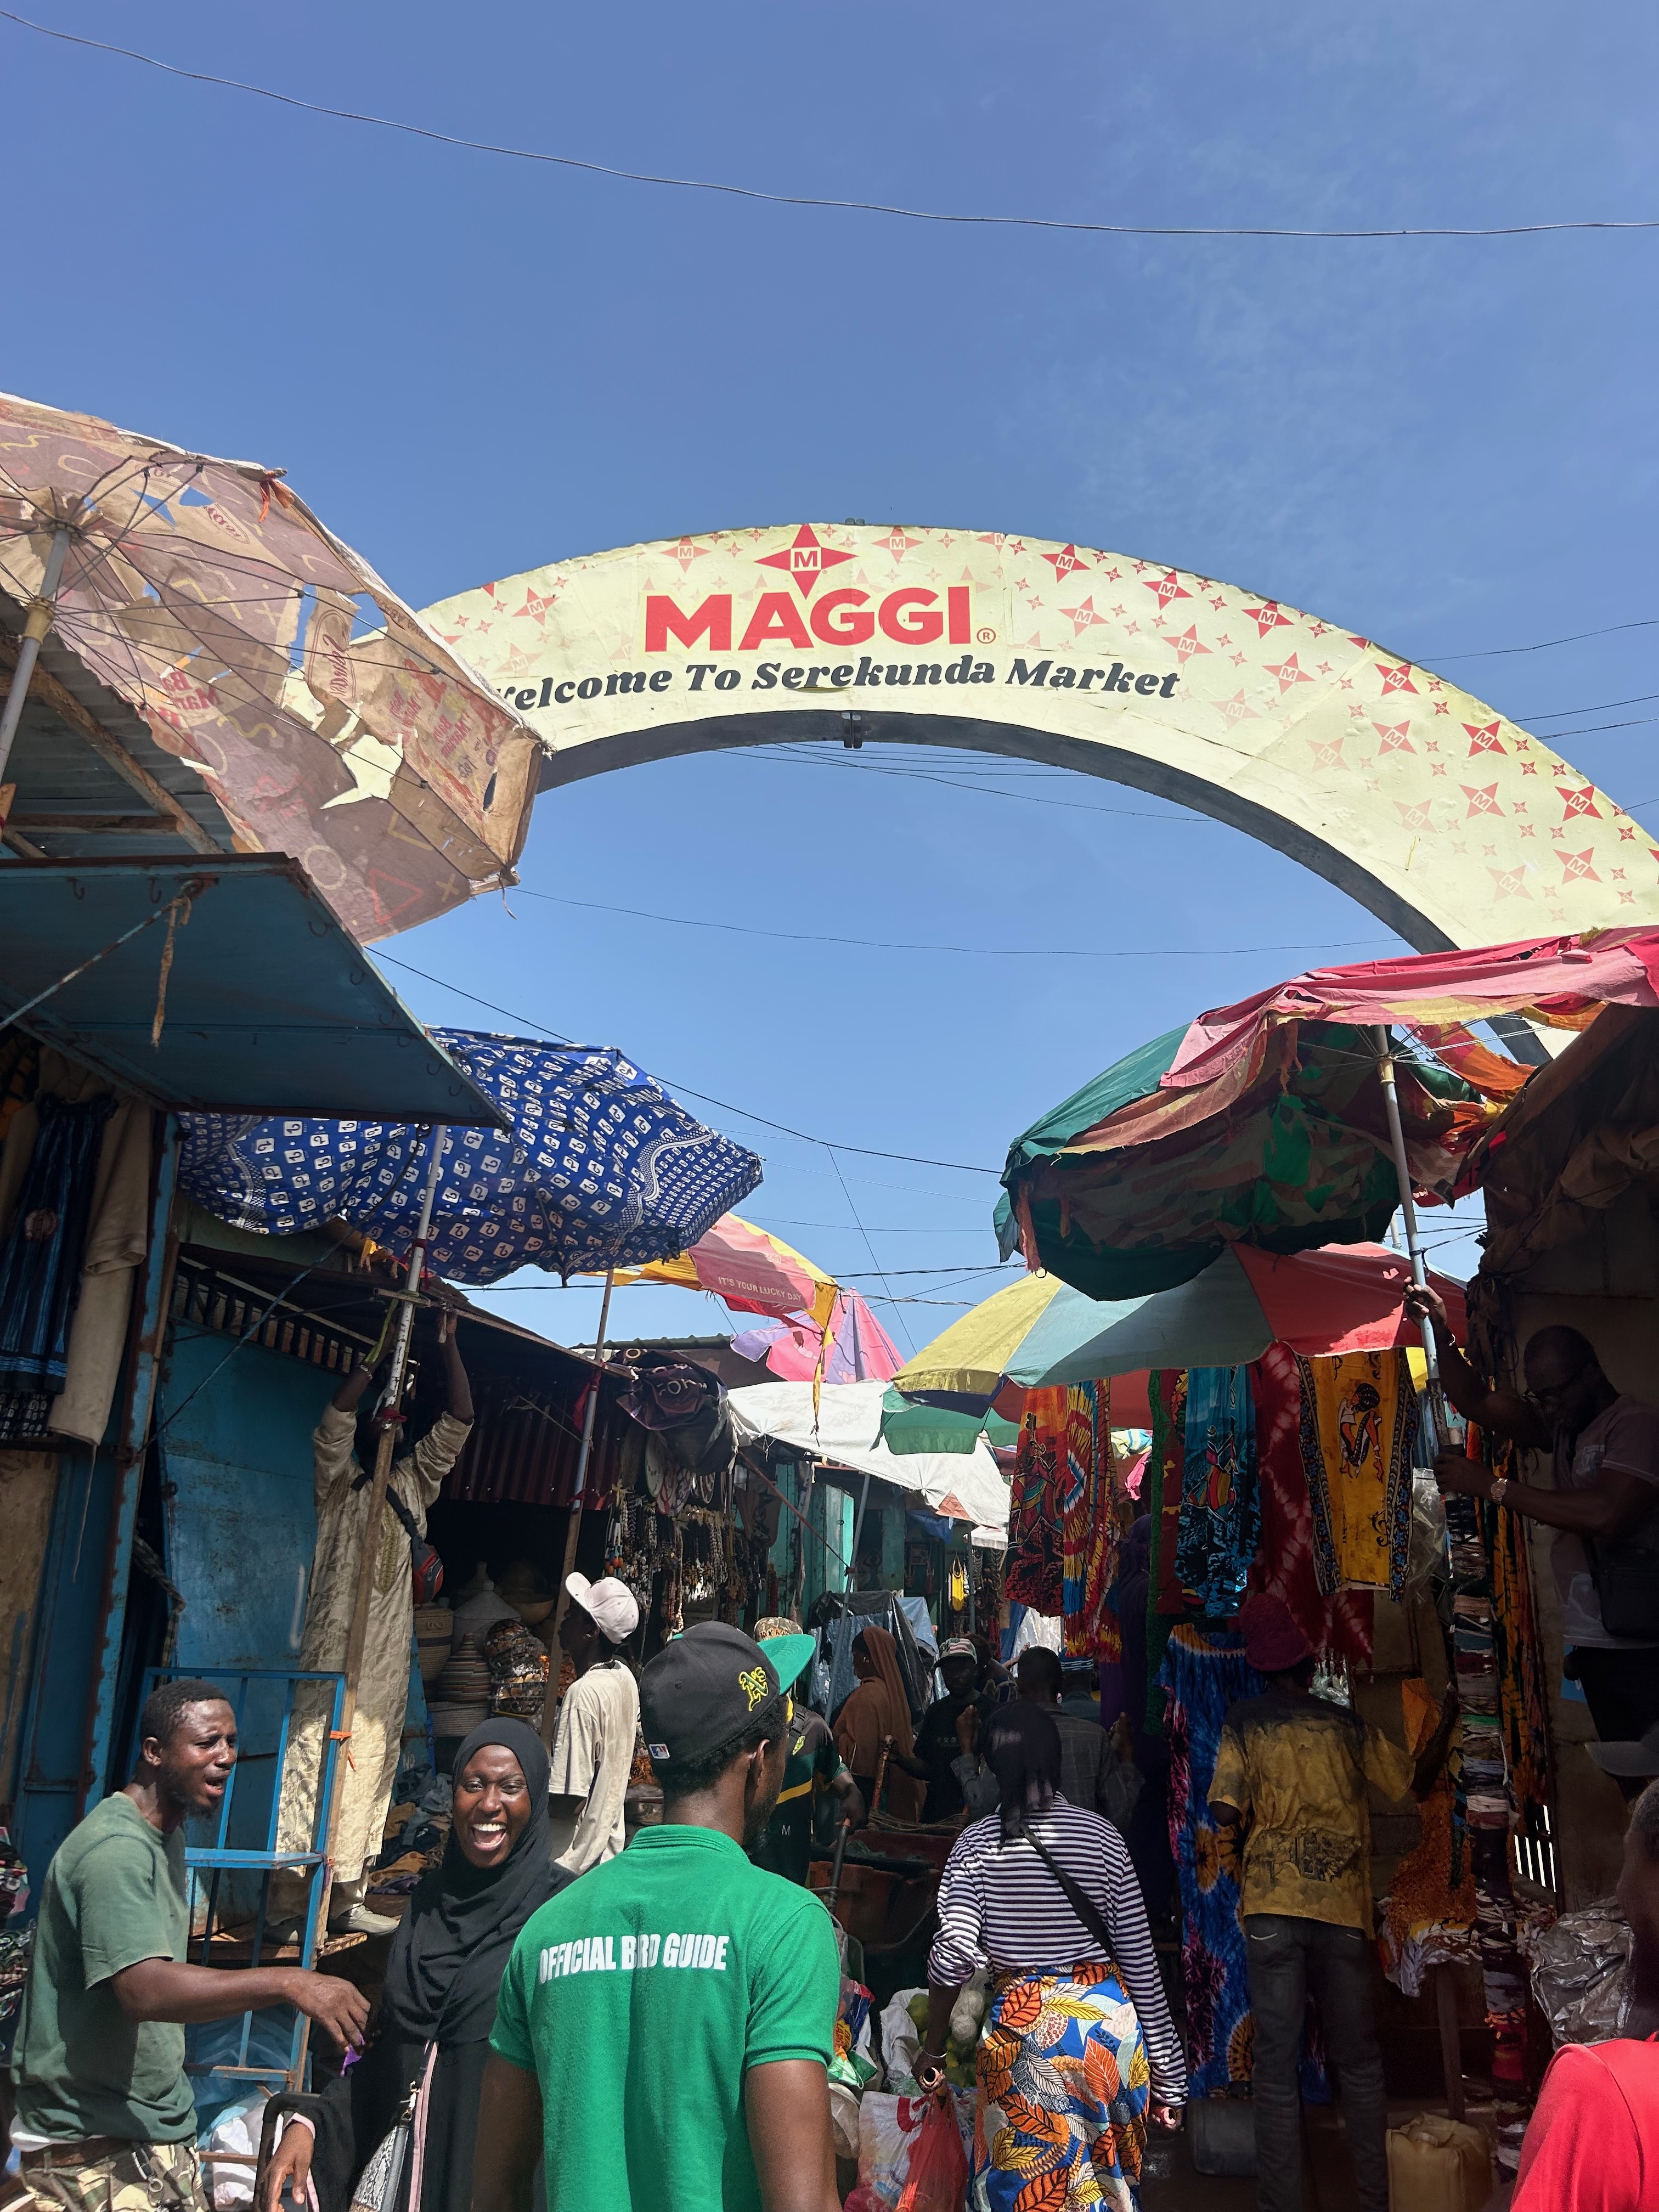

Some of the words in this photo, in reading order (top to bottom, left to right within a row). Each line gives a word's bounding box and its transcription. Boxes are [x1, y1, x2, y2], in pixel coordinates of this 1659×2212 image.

[891, 538, 904, 548] M
[680, 548, 692, 557] M
[794, 551, 817, 567] M
[1059, 556, 1072, 567] M
[1163, 584, 1174, 593] M
[530, 601, 541, 612] M
[645, 586, 971, 652] MAGGI
[1076, 611, 1089, 622] M
[1262, 611, 1275, 622] M
[1182, 640, 1193, 650] M
[686, 664, 741, 691] To
[751, 654, 995, 690] Serekunda
[1005, 658, 1180, 698] Market
[1283, 668, 1295, 678] M
[1390, 673, 1403, 685] M
[1387, 731, 1401, 744] M
[1477, 733, 1492, 746] M
[1477, 794, 1489, 806] M
[1573, 796, 1587, 809] M
[1572, 858, 1585, 871] M
[718, 1277, 735, 1286] IT'S
[736, 1280, 758, 1292] YOUR
[759, 1286, 785, 1298] LUCKY
[787, 1292, 802, 1302] DAY
[781, 1824, 791, 1836] M
[540, 1936, 617, 1984] OFFICIAL
[663, 1933, 730, 1970] GUIDE
